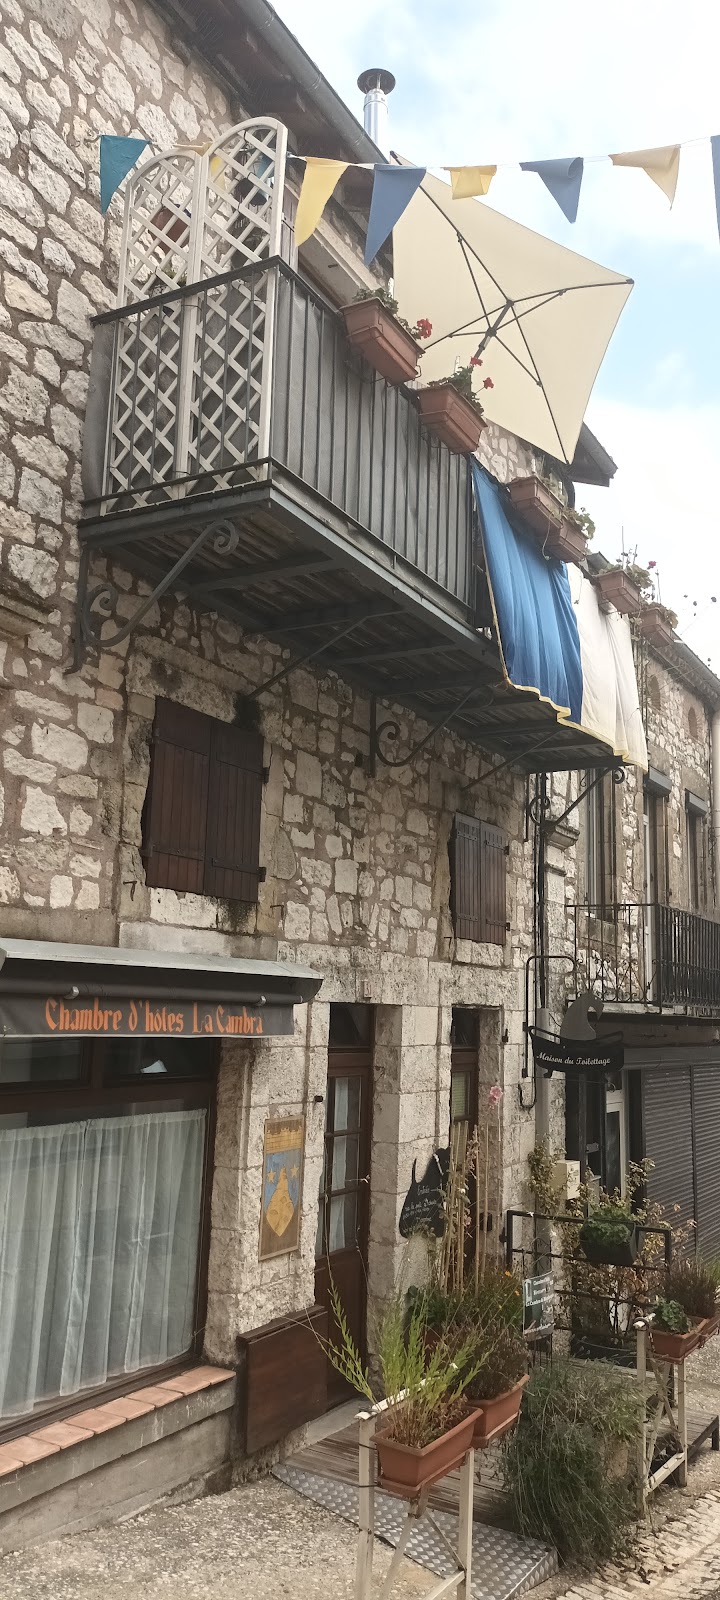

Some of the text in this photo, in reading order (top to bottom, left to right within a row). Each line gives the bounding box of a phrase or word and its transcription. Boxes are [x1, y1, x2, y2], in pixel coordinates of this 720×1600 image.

[45, 997, 123, 1031] Chambre
[192, 1002, 214, 1034] La
[216, 1004, 264, 1034] Cambra
[536, 1052, 611, 1067] Maison du Toilettage
